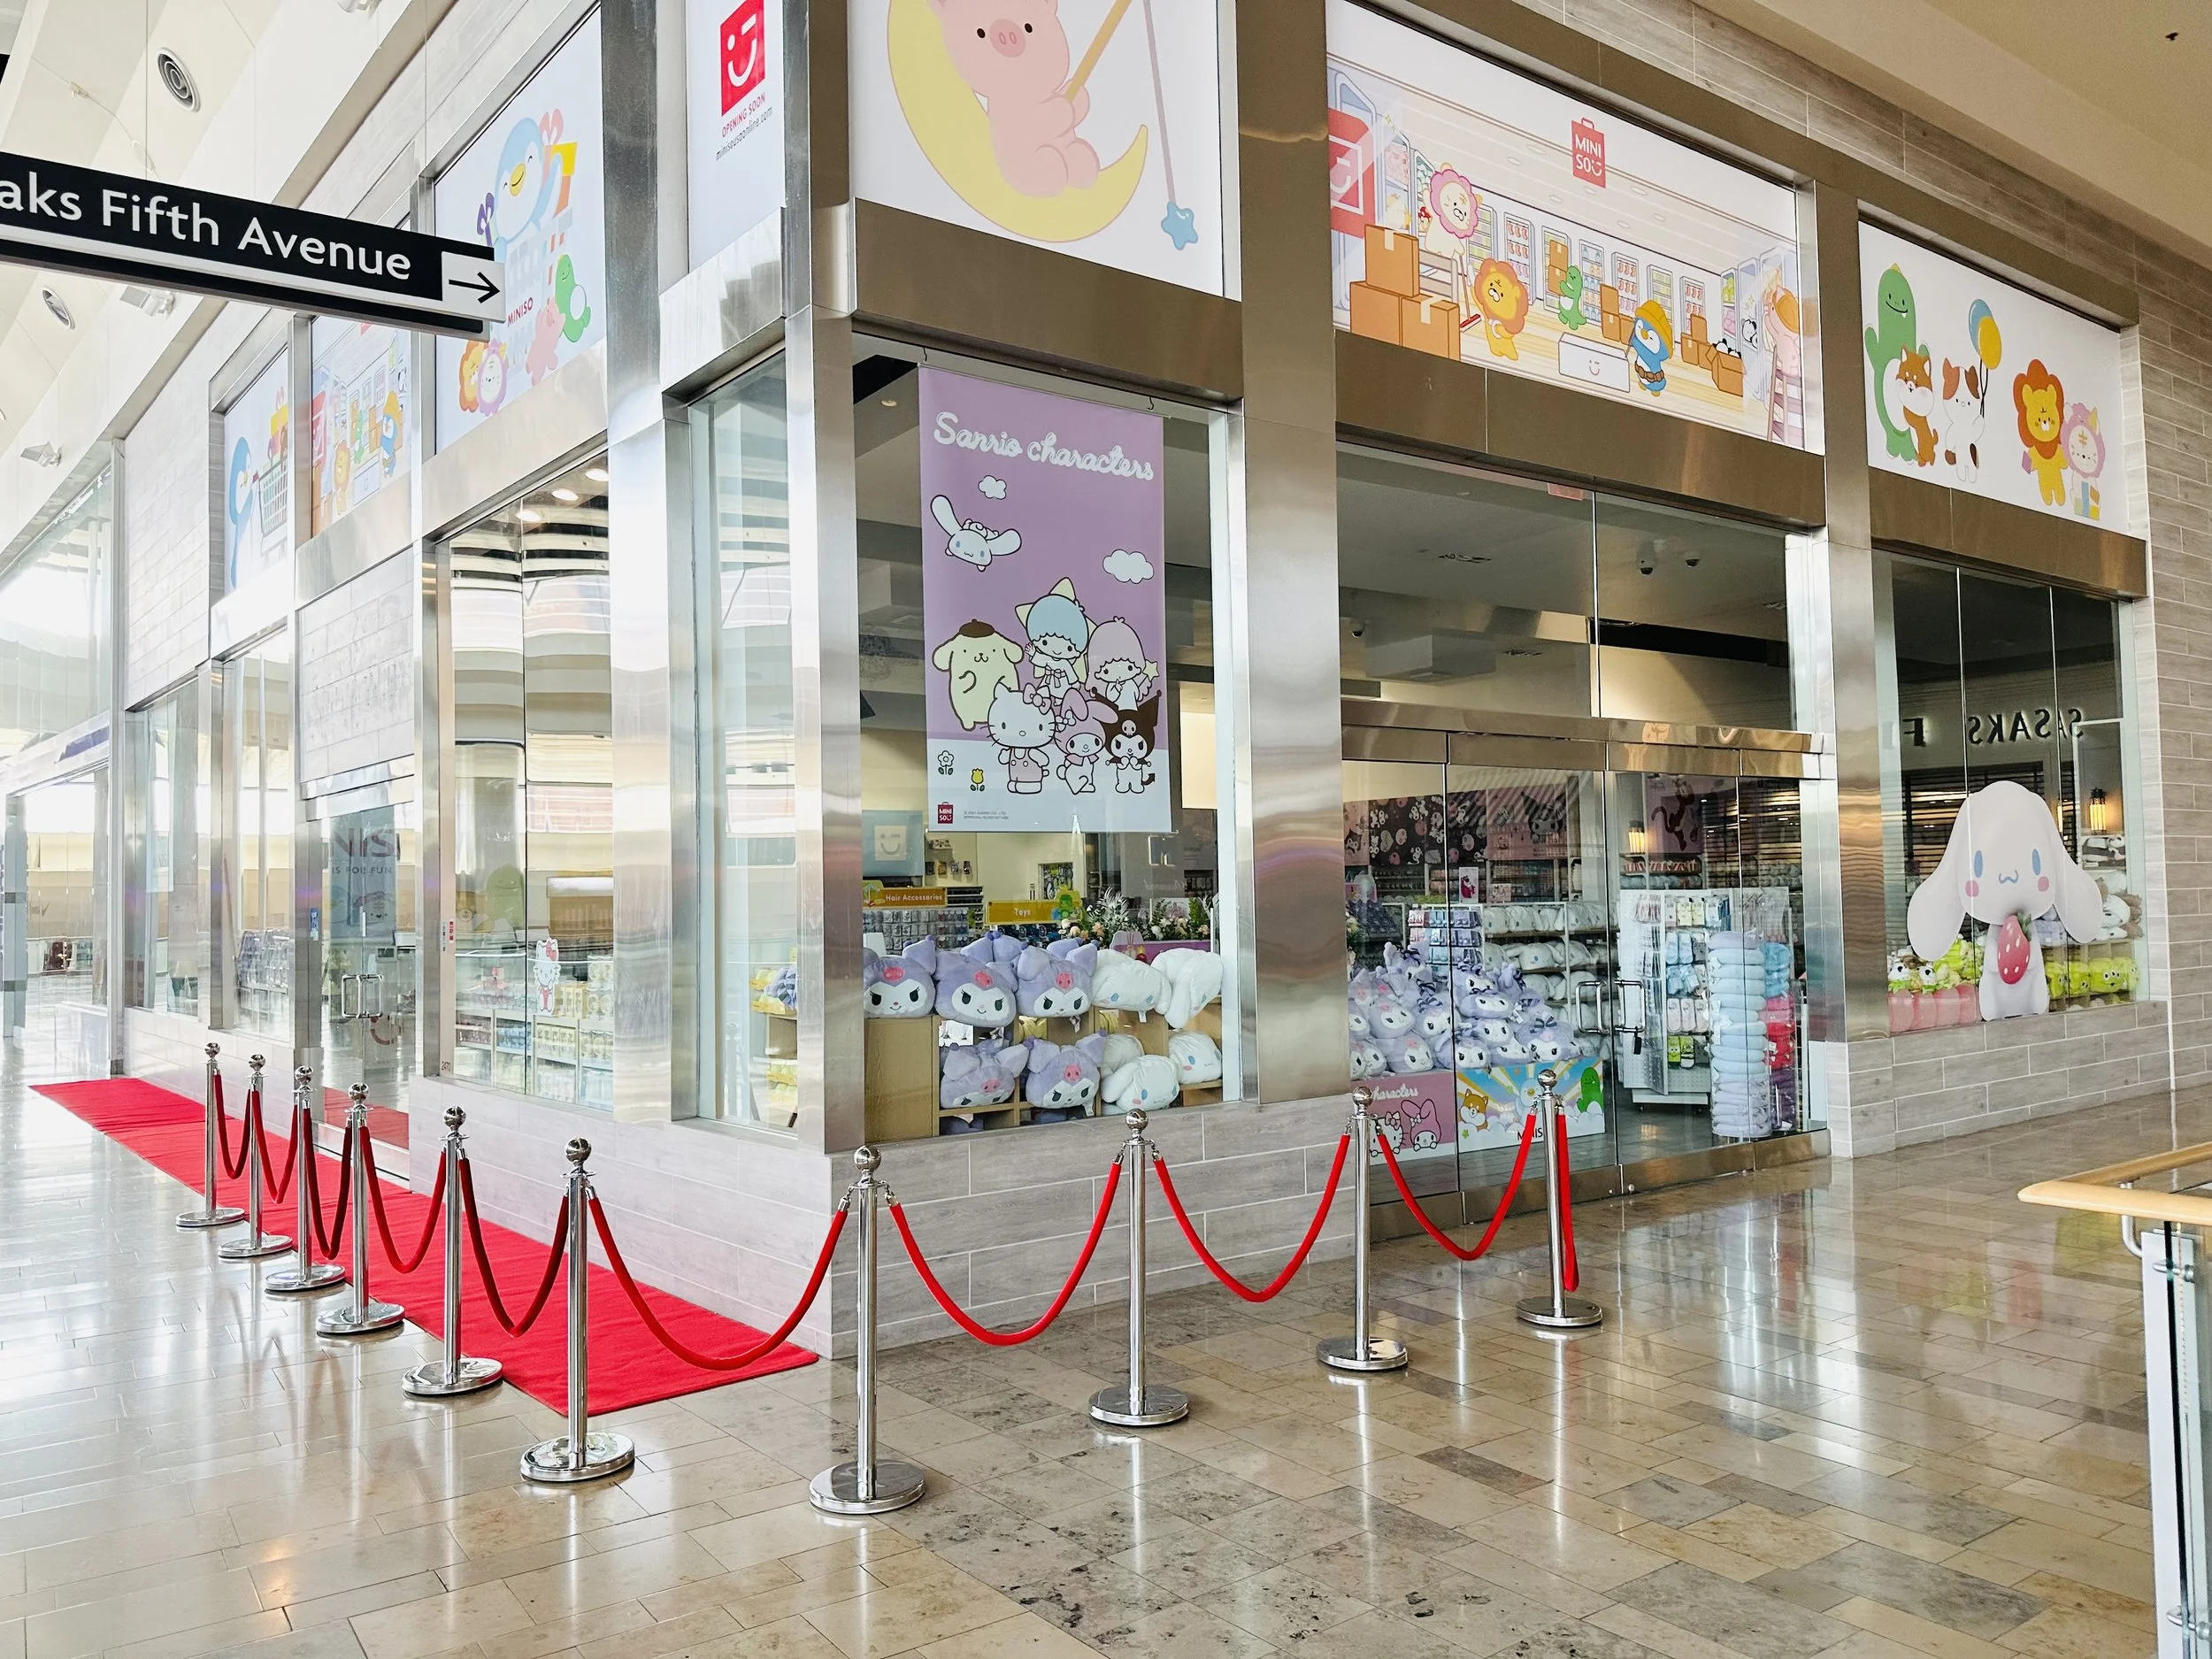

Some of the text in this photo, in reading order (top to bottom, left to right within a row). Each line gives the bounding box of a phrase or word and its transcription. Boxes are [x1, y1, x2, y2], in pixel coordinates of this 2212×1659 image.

[721, 92, 765, 138] OPENING SOON
[1574, 134, 1602, 159] MINI
[103, 188, 219, 246] Fifth
[237, 217, 411, 280] Avenue
[507, 296, 534, 327] MINISO
[933, 411, 1154, 481] Sanrio characters
[1014, 908, 1031, 917] Toys
[1372, 1083, 1419, 1101] haracters
